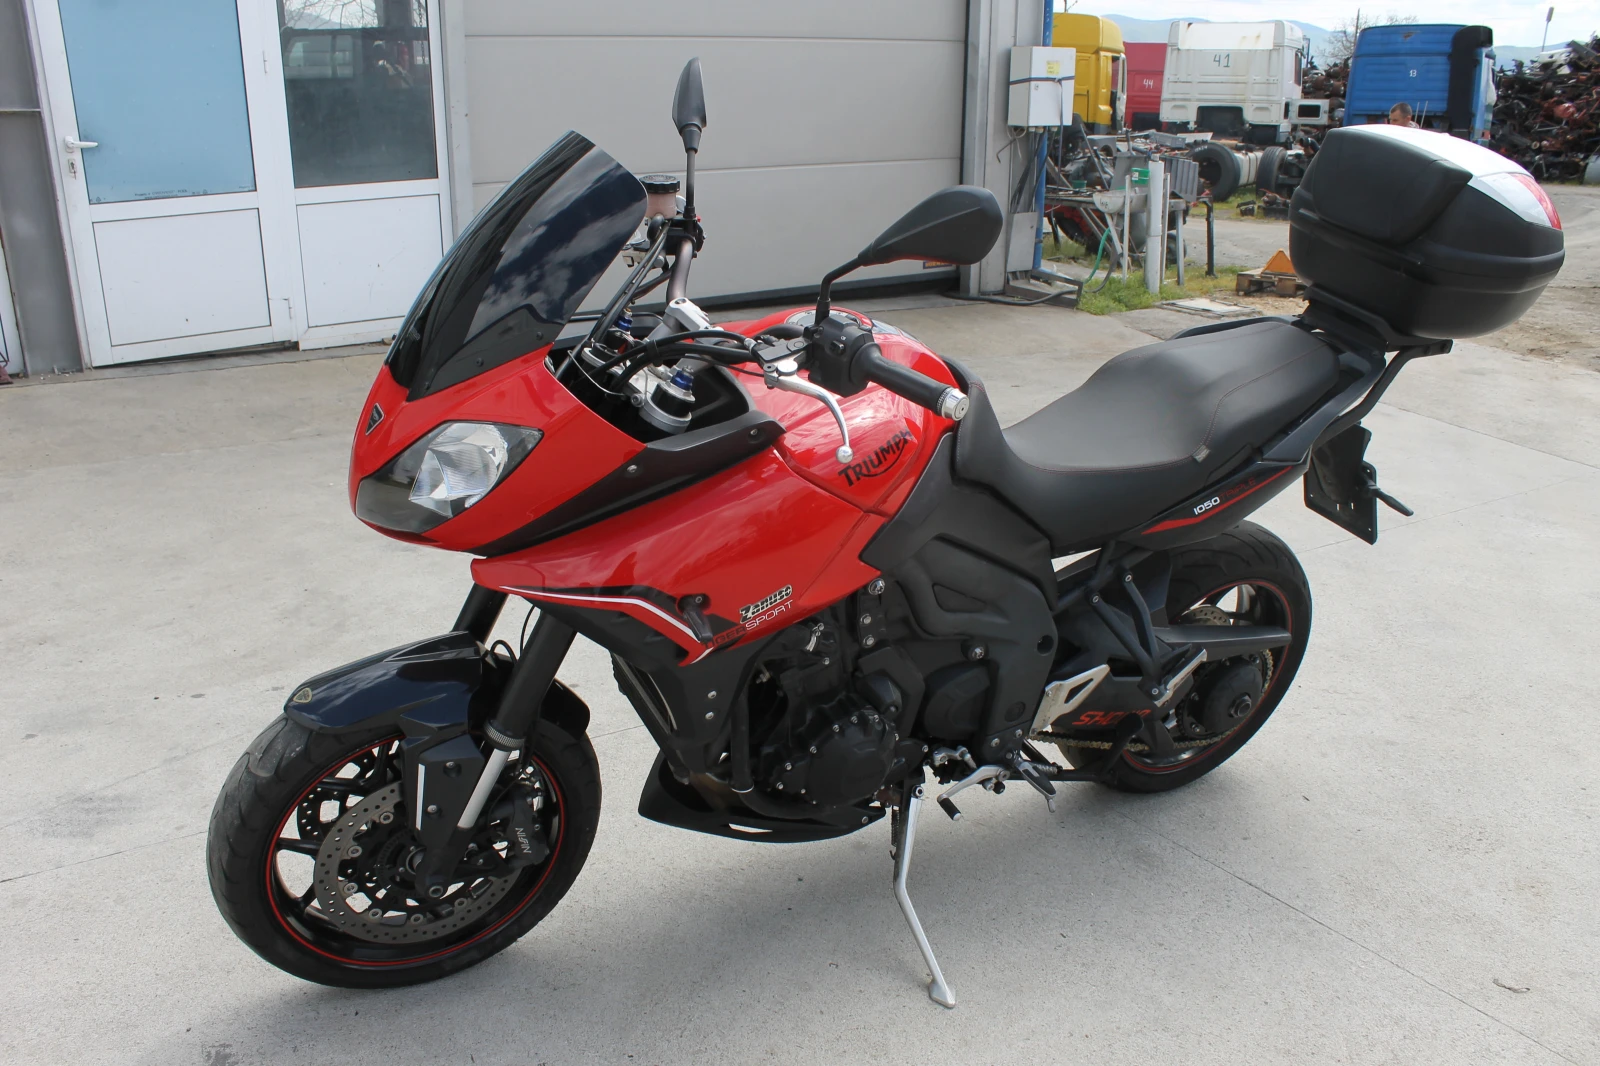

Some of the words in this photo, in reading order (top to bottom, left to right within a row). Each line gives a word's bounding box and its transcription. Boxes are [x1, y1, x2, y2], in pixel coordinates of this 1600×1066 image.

[1213, 53, 1230, 68] 41
[1142, 78, 1154, 89] 44
[838, 427, 912, 487] TRIUMPH
[1193, 496, 1220, 515] 1050
[745, 600, 793, 631] SPORT
